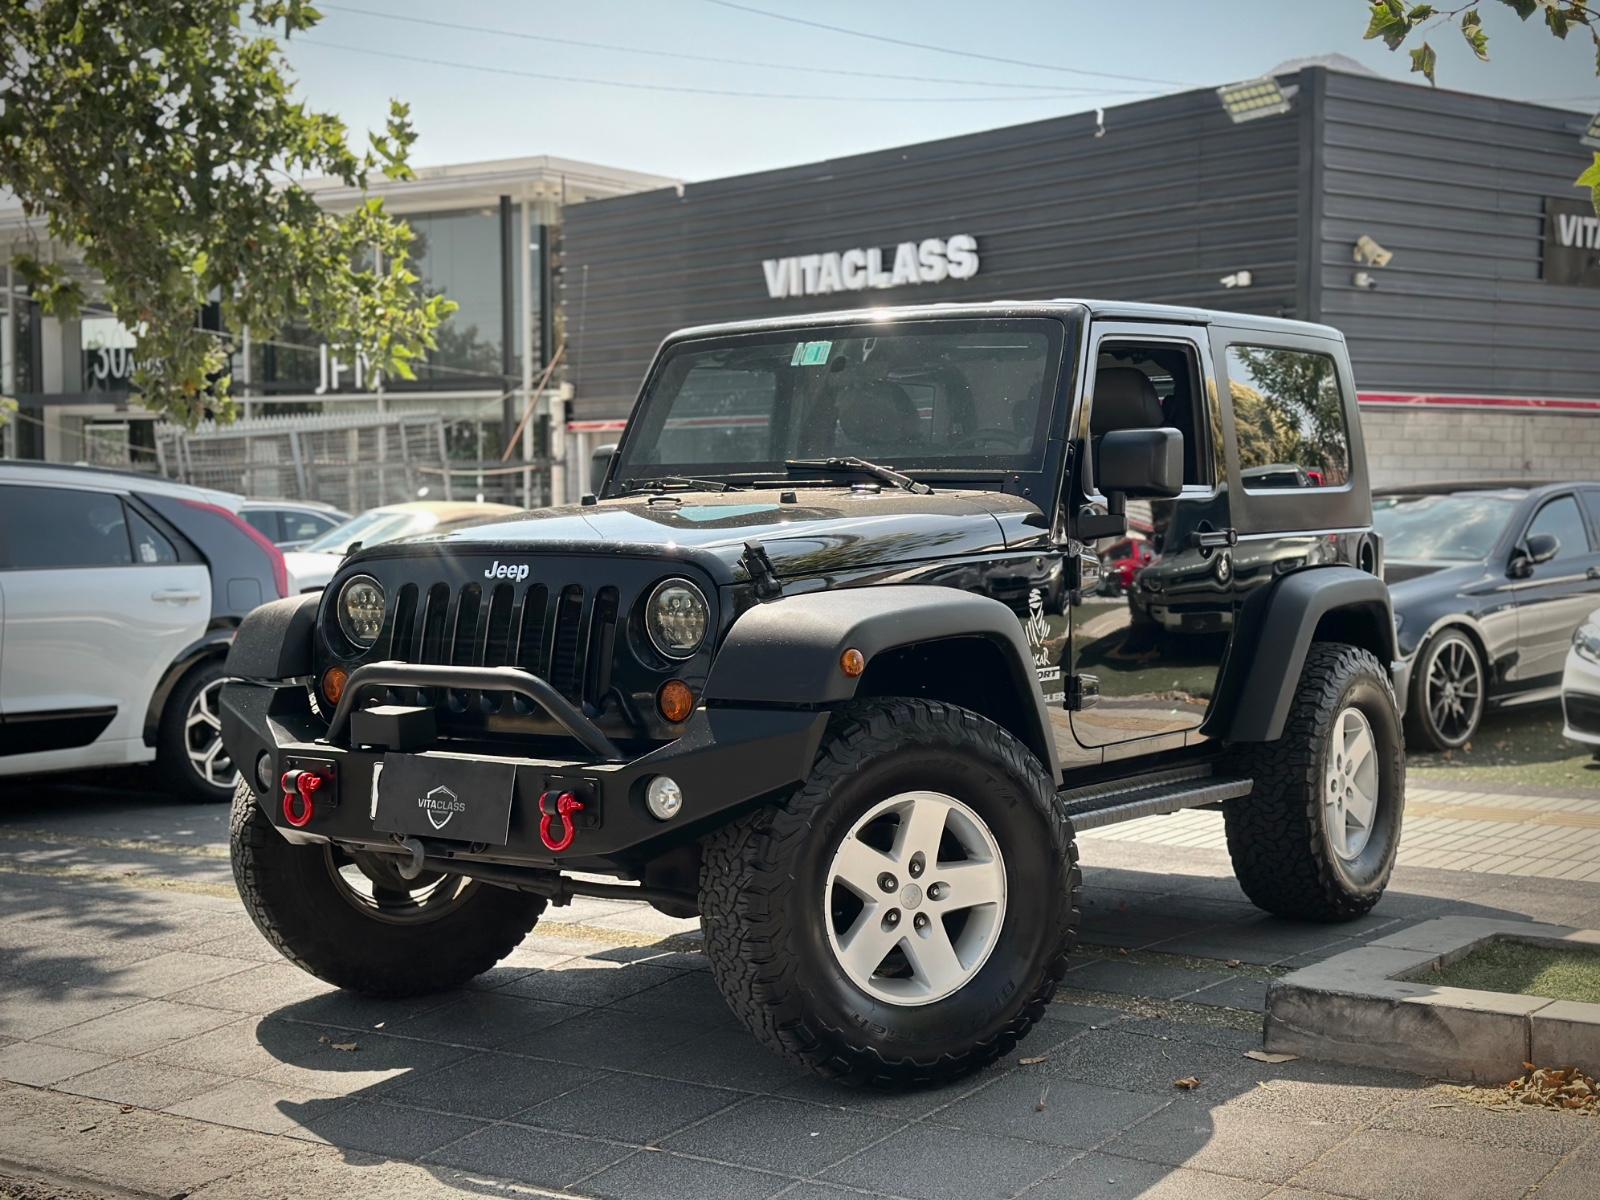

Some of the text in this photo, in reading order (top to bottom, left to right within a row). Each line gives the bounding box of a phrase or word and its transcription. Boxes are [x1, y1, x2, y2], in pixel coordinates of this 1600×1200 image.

[762, 234, 979, 299] VITACLASS
[484, 560, 530, 583] Jeep
[1032, 647, 1051, 666] KAR
[418, 798, 465, 812] VITACLASS
